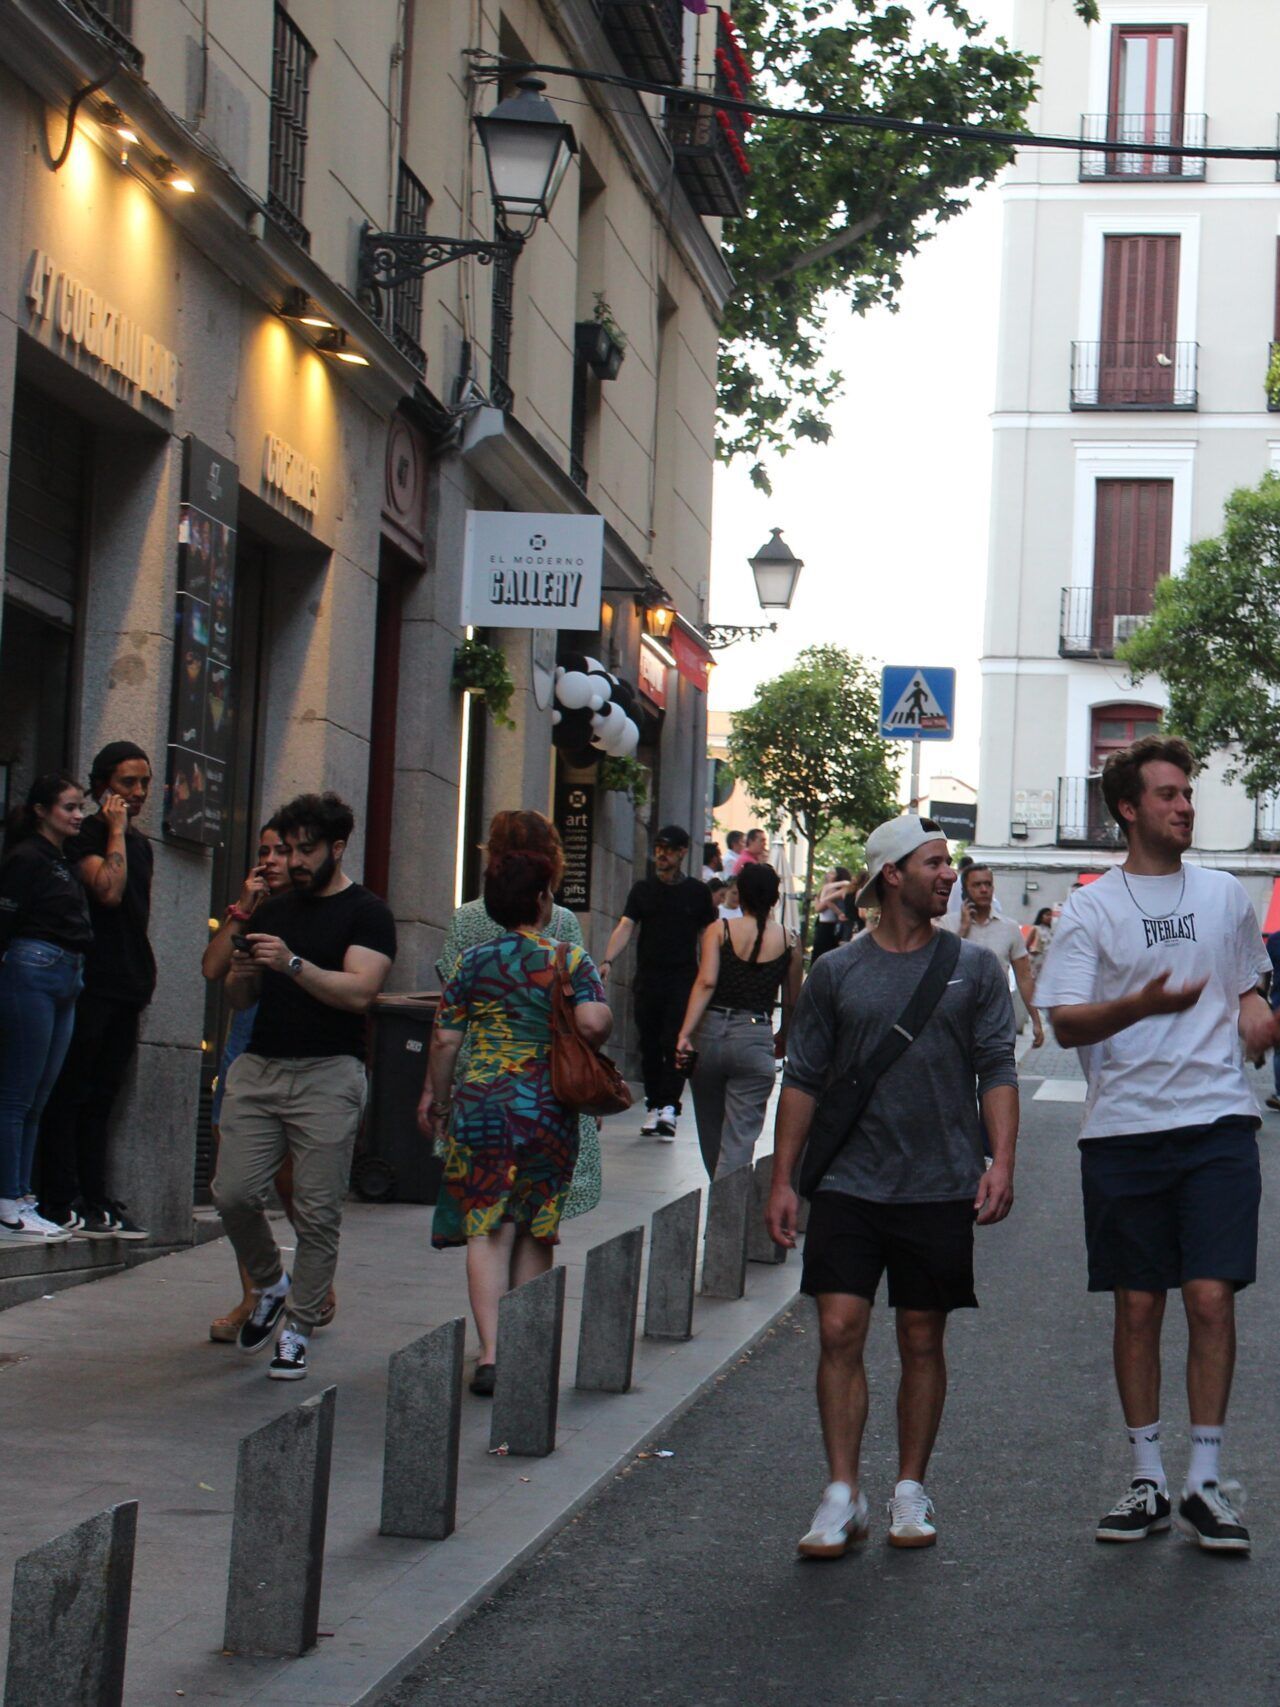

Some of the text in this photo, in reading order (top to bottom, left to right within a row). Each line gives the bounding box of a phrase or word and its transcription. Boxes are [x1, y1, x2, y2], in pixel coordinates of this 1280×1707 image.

[27, 249, 180, 412] 47 COCKTAIL BAR
[490, 555, 585, 567] EL MODERNO
[489, 568, 583, 608] GALLERY
[565, 814, 588, 827] art
[563, 884, 586, 897] gifts
[1141, 912, 1197, 948] EVERLAST
